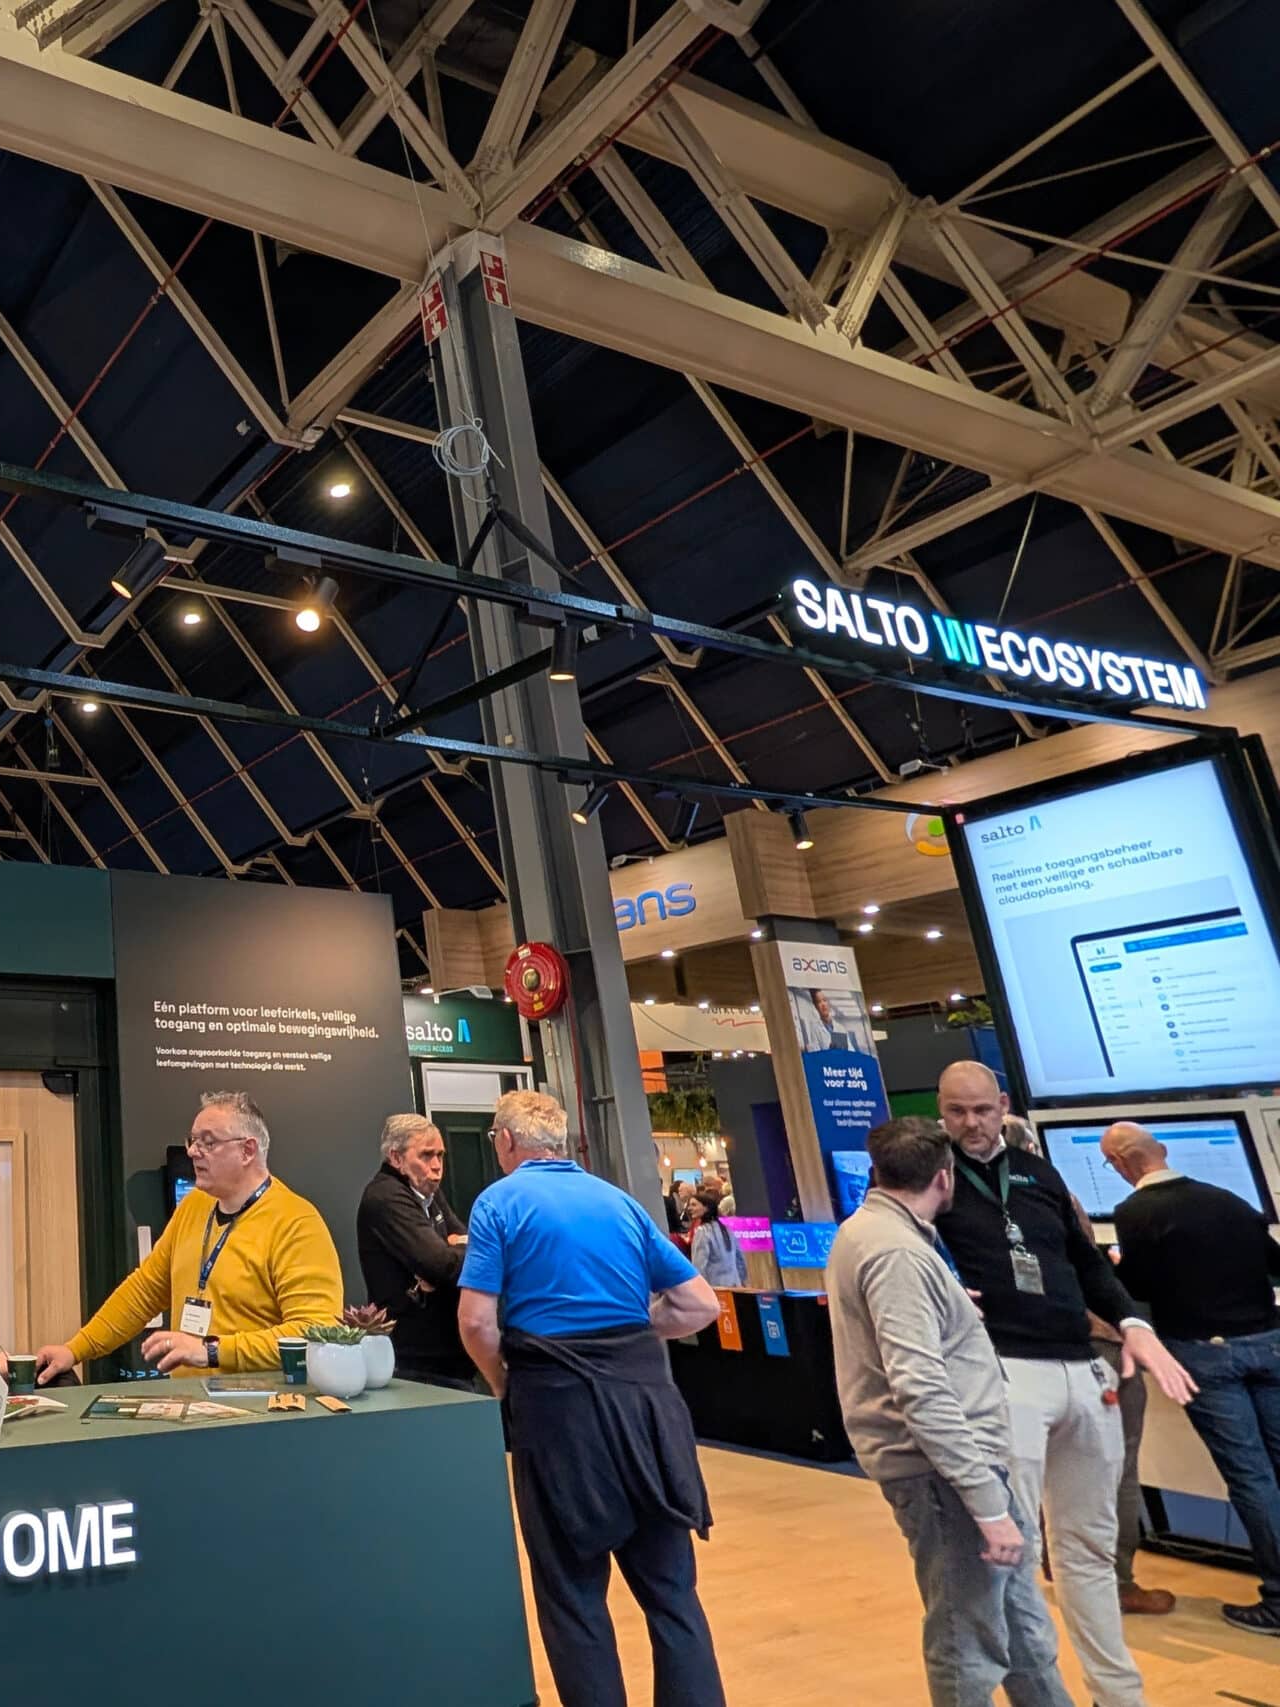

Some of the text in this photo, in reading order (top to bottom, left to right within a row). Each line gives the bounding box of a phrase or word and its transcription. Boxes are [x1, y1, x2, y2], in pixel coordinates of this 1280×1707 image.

[792, 579, 1208, 710] SALTO WECOSYSTEM
[981, 823, 1025, 844] salto
[992, 865, 1042, 883] Realtime
[1045, 840, 1153, 871] toegangsbeheer
[995, 846, 1183, 895] met een veilige en schaalbare
[998, 879, 1095, 906] cloudoplossing.
[792, 957, 848, 975] axians
[153, 1000, 357, 1025] Eén platform voor leefcirkels, veilige
[154, 1017, 379, 1039] toegang en optimale bewegingsvrijheid.
[405, 1020, 453, 1042] salto
[156, 1047, 188, 1056] Voorkom
[242, 1050, 271, 1059] toegang
[215, 1061, 229, 1069] met
[230, 1062, 271, 1071] technologie
[273, 1062, 284, 1070] die
[823, 1066, 847, 1077] Meer
[823, 1079, 868, 1091] voor zorg
